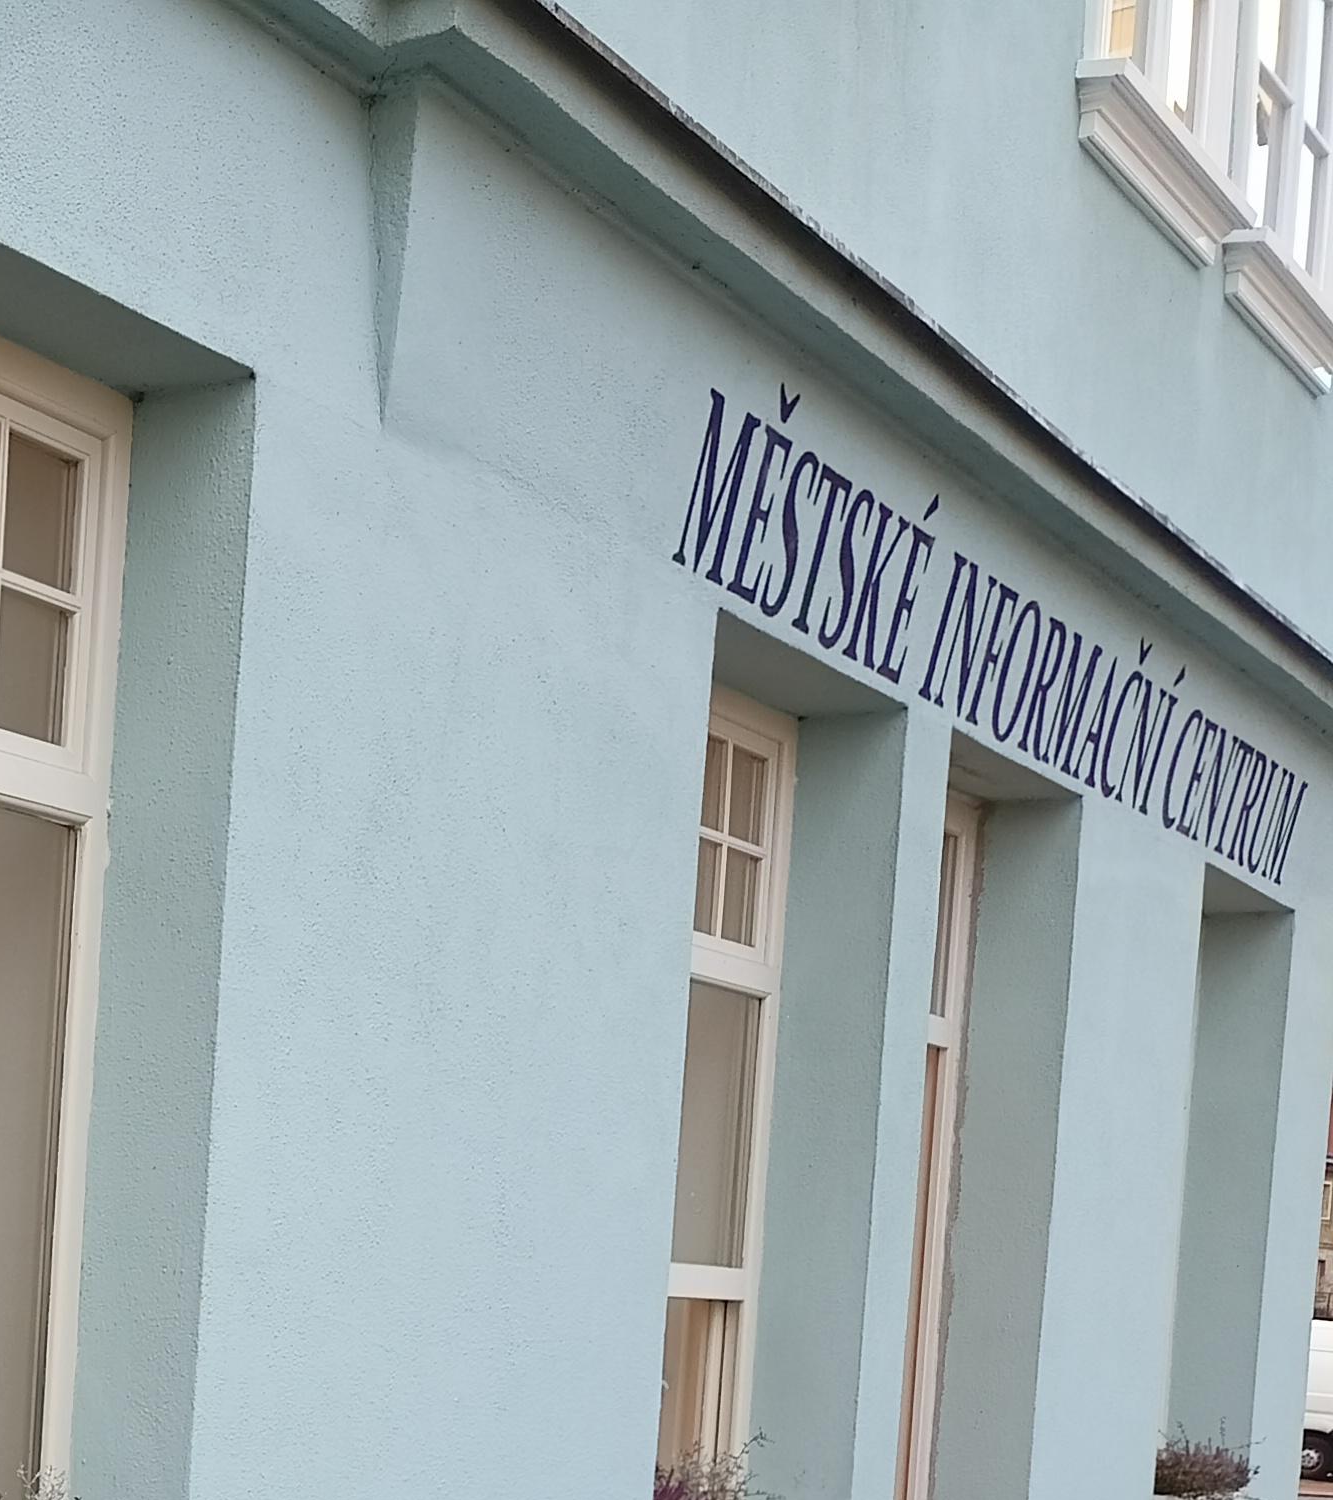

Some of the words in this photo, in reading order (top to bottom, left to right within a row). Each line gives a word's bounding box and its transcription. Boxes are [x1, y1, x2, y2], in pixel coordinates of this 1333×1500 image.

[671, 382, 940, 685] MĚSTSKÉ
[917, 551, 1187, 816] INFORMAČNÍ
[1160, 707, 1309, 886] CENTRUM
